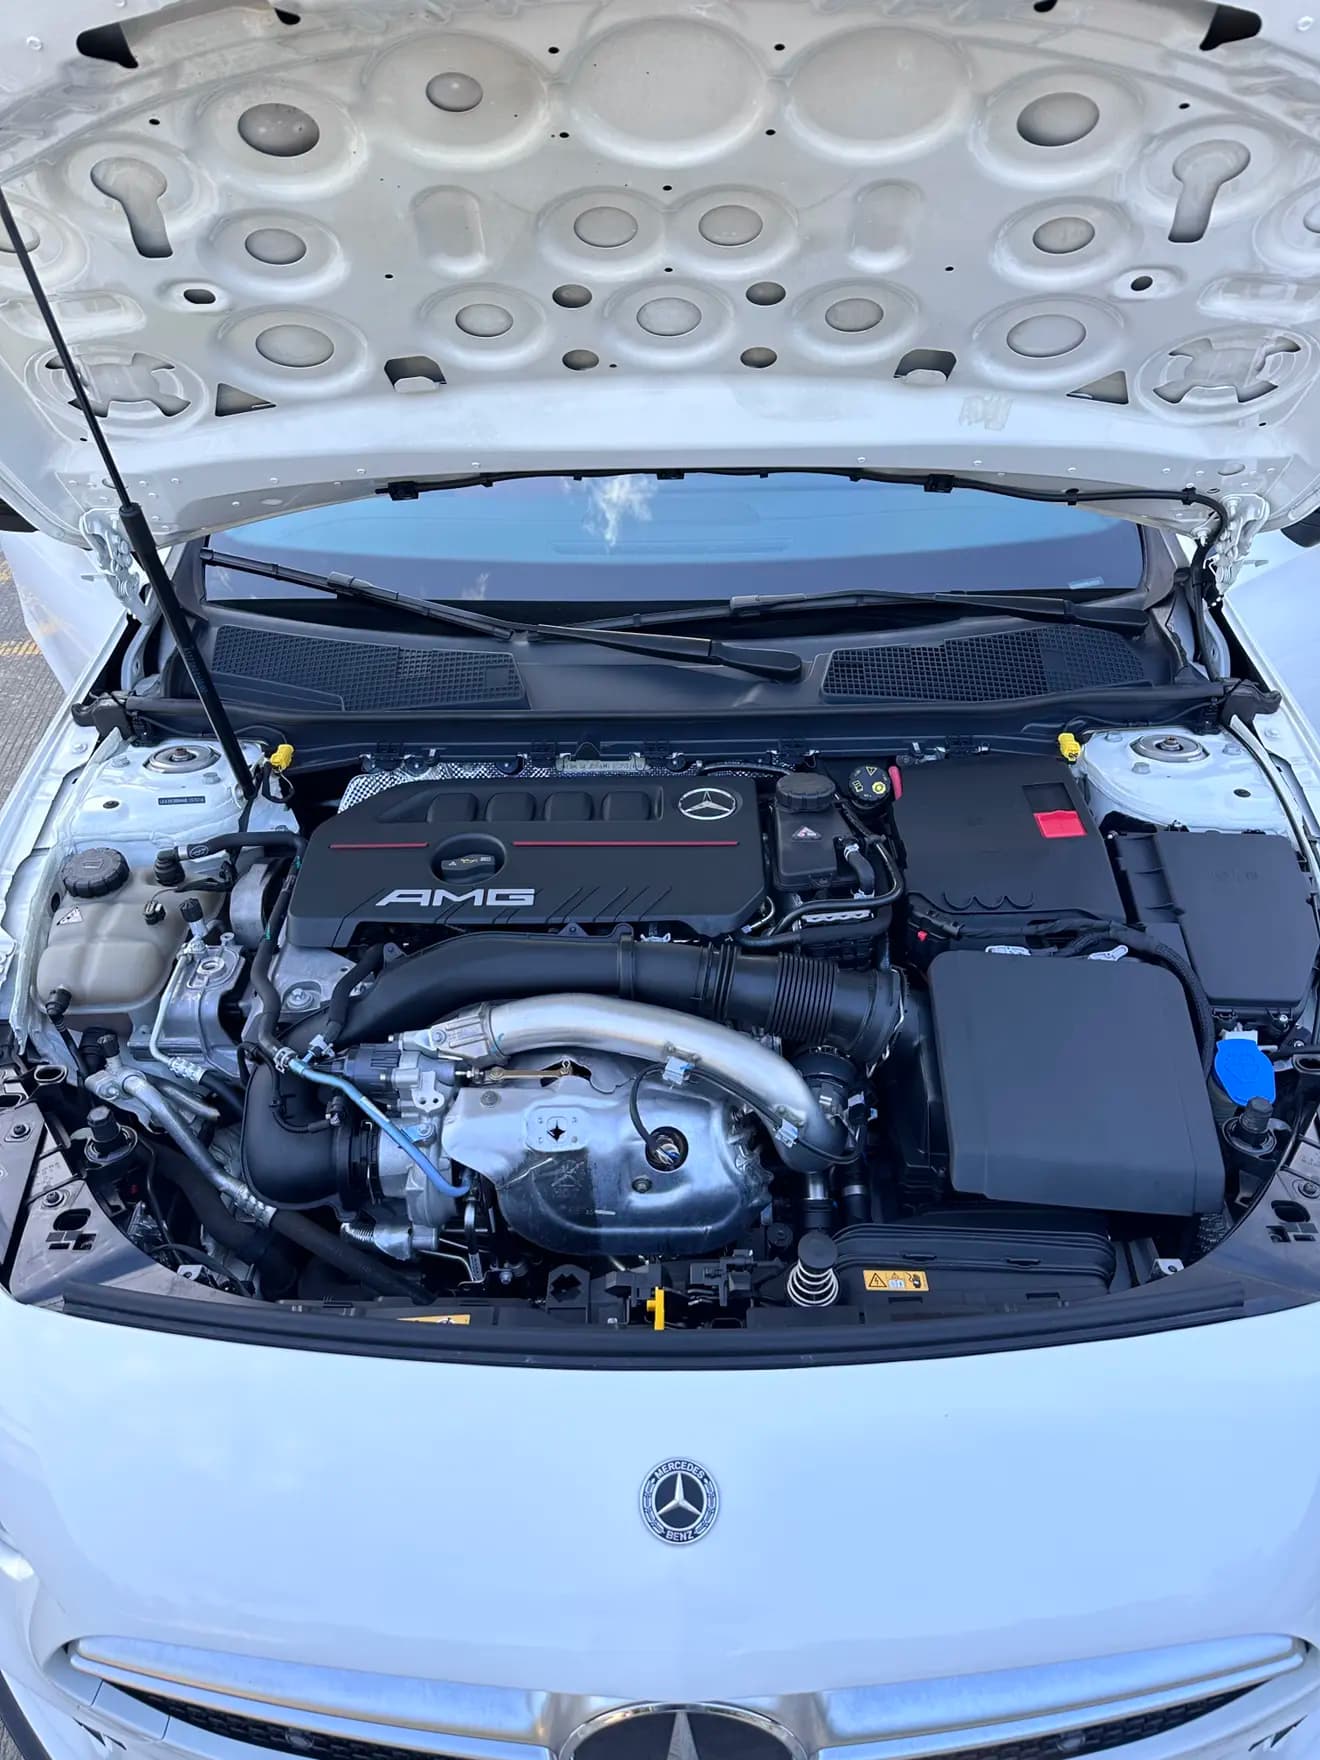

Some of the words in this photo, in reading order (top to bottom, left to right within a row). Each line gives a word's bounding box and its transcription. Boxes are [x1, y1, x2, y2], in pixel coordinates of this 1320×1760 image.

[376, 889, 535, 906] AMG
[654, 1461, 705, 1479] MERCEDES
[666, 1530, 694, 1541] BENZ
